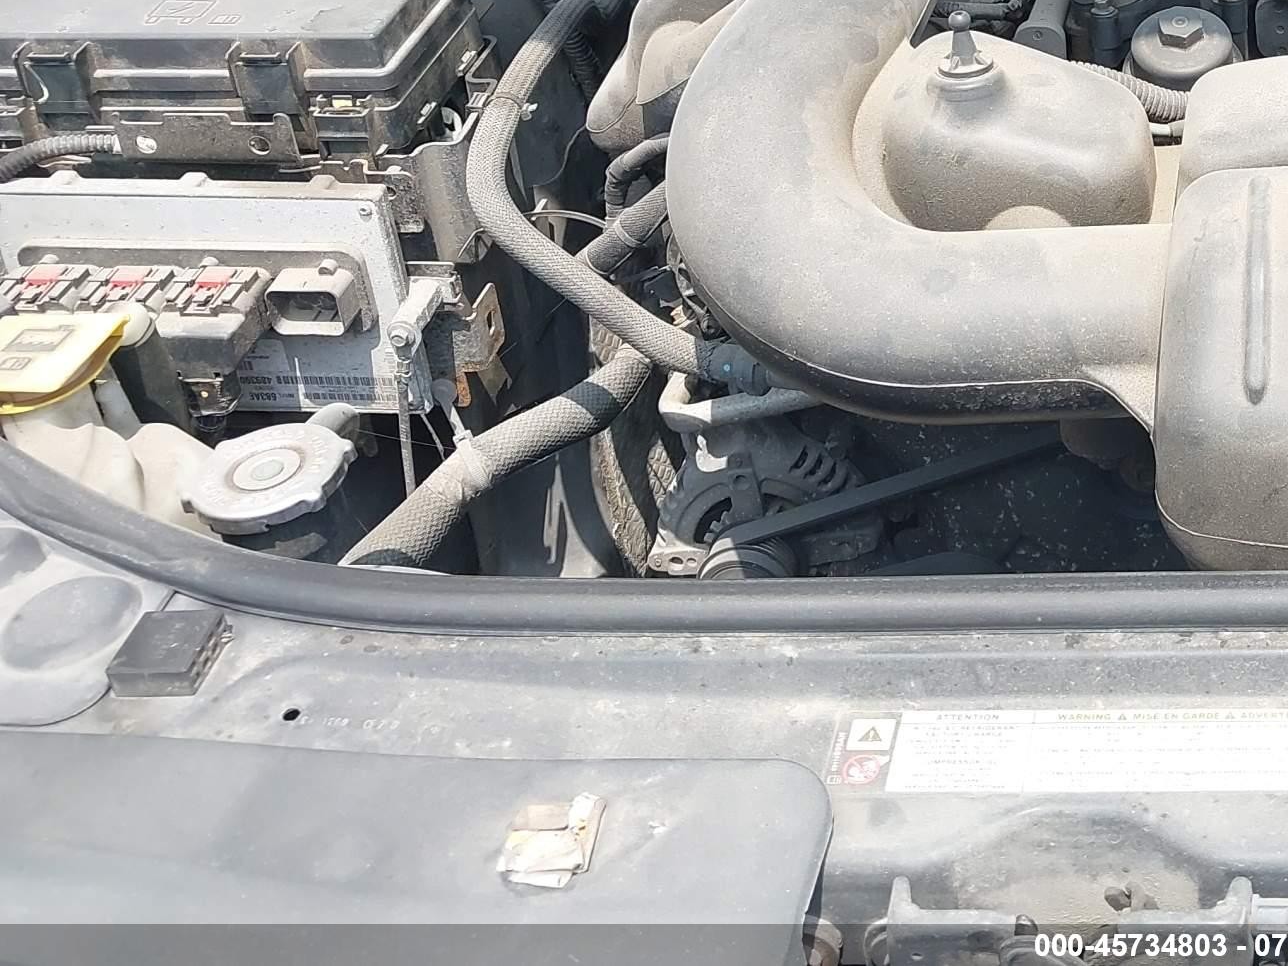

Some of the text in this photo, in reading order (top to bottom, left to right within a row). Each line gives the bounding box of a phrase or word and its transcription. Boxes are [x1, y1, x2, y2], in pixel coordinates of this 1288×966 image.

[936, 713, 1000, 721] ATTENTION
[1057, 713, 1112, 721] WARNING
[1133, 713, 1160, 721] MISE
[1182, 712, 1220, 720] GARDE
